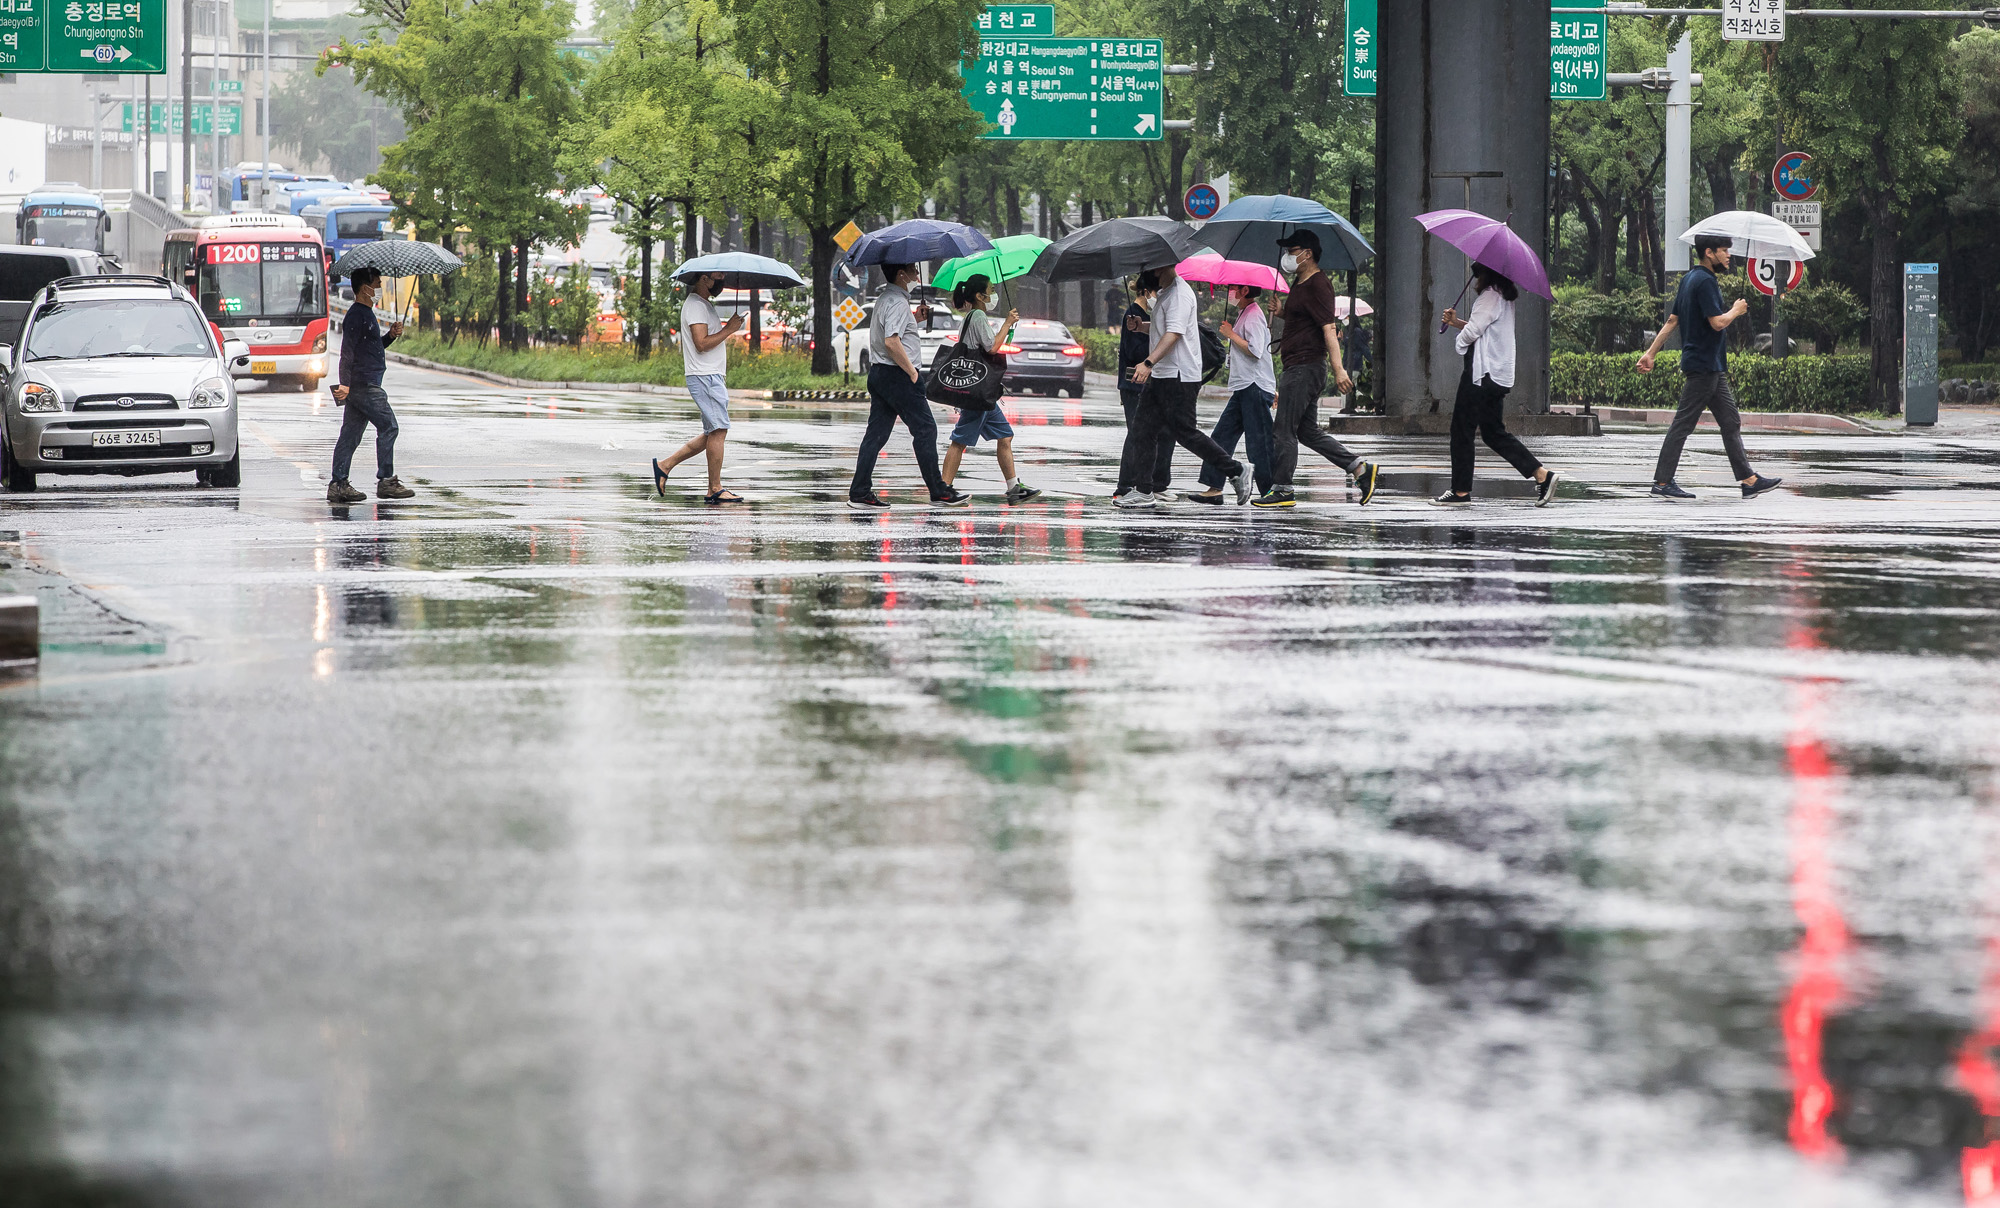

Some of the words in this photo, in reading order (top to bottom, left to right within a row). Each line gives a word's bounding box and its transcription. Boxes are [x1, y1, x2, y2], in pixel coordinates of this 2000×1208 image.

[65, 2, 140, 22] 충정로역
[64, 25, 126, 40] Chungjeongno
[128, 26, 143, 38] Stn
[1726, 18, 1782, 35] 직좌신호
[0, 32, 18, 50] 역
[1353, 27, 1371, 45] 숭
[98, 48, 111, 58] 60
[982, 41, 1029, 57] 한강대교
[1100, 43, 1158, 58] 원효대교
[1355, 48, 1369, 64] 崇
[986, 60, 1029, 75] 서울역
[1031, 65, 1057, 76] Seoul
[1058, 66, 1074, 76] Stn
[985, 80, 1029, 96] 숭례문
[1560, 82, 1578, 93] Stn
[1031, 90, 1088, 102] Sungnyemun
[1100, 91, 1125, 102] Seoul
[1127, 91, 1143, 102] Stn
[1001, 113, 1014, 124] 21
[42, 208, 63, 217] 7154
[212, 244, 259, 262] 1200
[298, 247, 316, 259] 서울역
[126, 432, 155, 444] 3245
